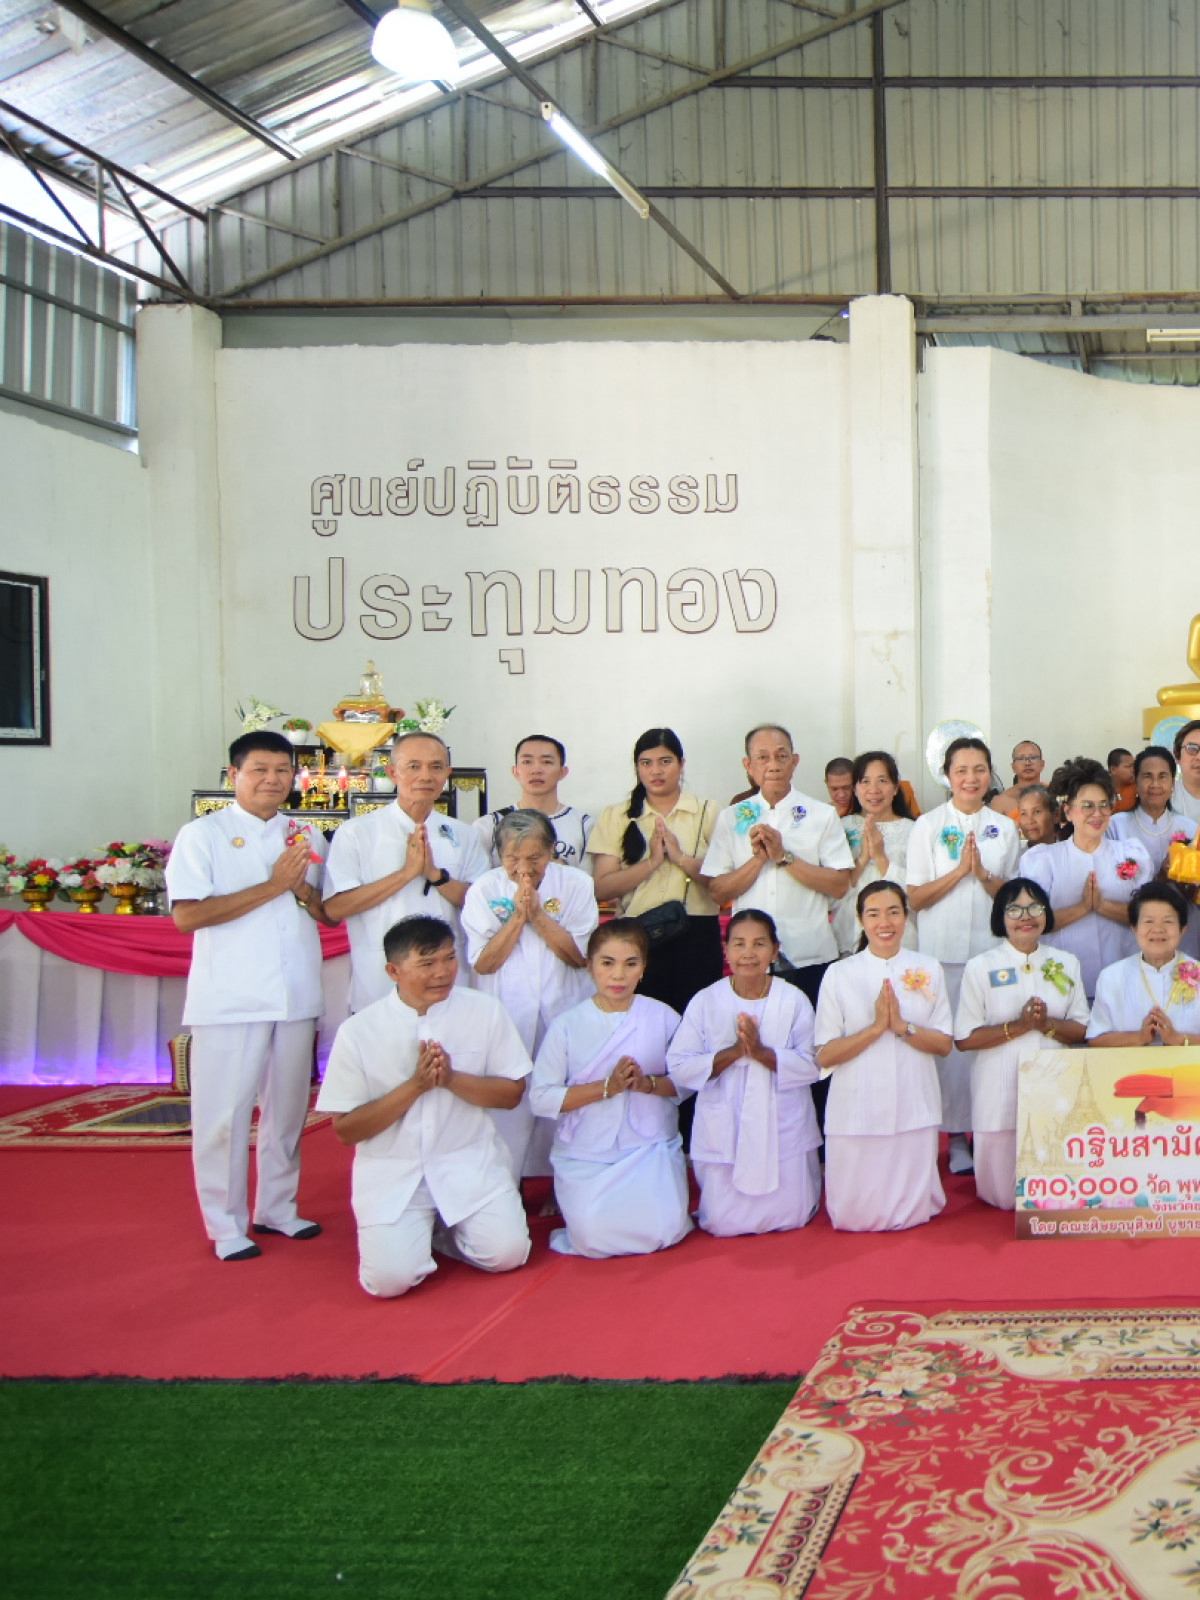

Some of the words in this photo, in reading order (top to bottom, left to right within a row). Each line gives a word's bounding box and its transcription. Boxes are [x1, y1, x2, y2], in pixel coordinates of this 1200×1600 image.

[311, 456, 739, 536] ศูนย์ปฏิบัติธรรม
[293, 556, 777, 674] ประทุมทอง
[1027, 1176, 1139, 1200] ๓๐,๐๐๐
[1147, 1172, 1170, 1194] วัด
[1030, 1218, 1056, 1234] โดย
